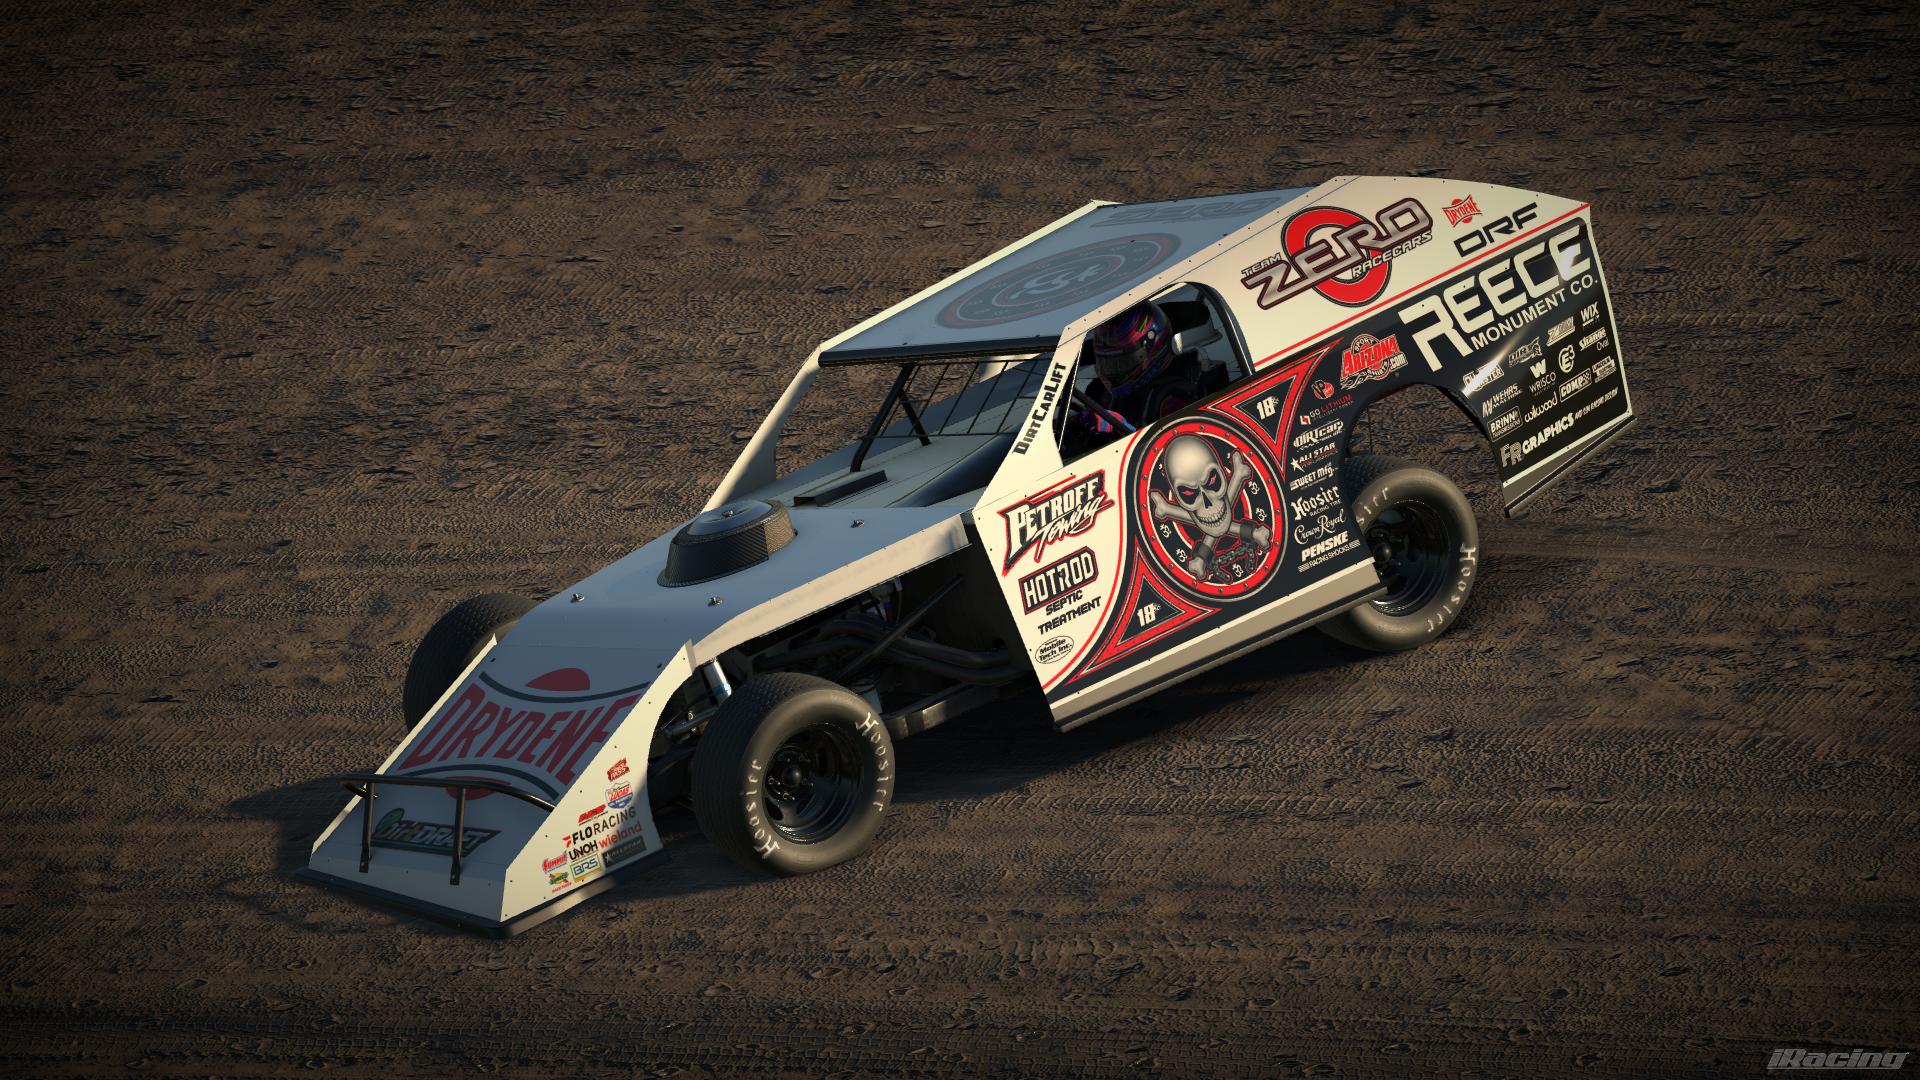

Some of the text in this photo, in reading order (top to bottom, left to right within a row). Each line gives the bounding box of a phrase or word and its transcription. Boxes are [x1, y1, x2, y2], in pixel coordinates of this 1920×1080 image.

[1443, 198, 1481, 223] DRYDENE
[1454, 203, 1537, 257] DRF
[1241, 198, 1433, 310] ZERO
[1241, 252, 1282, 277] TEAM
[1351, 231, 1432, 278] RACECARS
[1399, 226, 1591, 372] REECE
[1581, 302, 1599, 322] WIX
[1470, 288, 1566, 350] MONUMENT
[1570, 275, 1598, 296] CO.
[1354, 338, 1374, 352] SPORT
[1492, 383, 1518, 404] WEHRS
[1529, 372, 1557, 394] WRISCO
[1310, 409, 1320, 418] GO
[1524, 391, 1557, 423] wilwood
[1490, 411, 1516, 433] BRINN
[1522, 413, 1575, 454] GRAPHICS
[1290, 471, 1316, 491] SWEET
[1290, 486, 1340, 520] Hoosier
[1310, 505, 1330, 517] RACING
[1006, 477, 1099, 558] PETROFF
[1029, 494, 1112, 564] Towing
[1315, 508, 1346, 539] Royal
[1301, 531, 1348, 562] PENSKE
[1309, 545, 1350, 568] RACING SHOCKS
[1037, 596, 1102, 636] TREATMENT
[1045, 590, 1083, 616] SEPTIC
[1039, 638, 1067, 656] Mobile
[1039, 648, 1057, 664] Tech
[1056, 642, 1073, 655] Inc.
[568, 821, 642, 861] UNOH wieland
[573, 857, 598, 876] BRS
